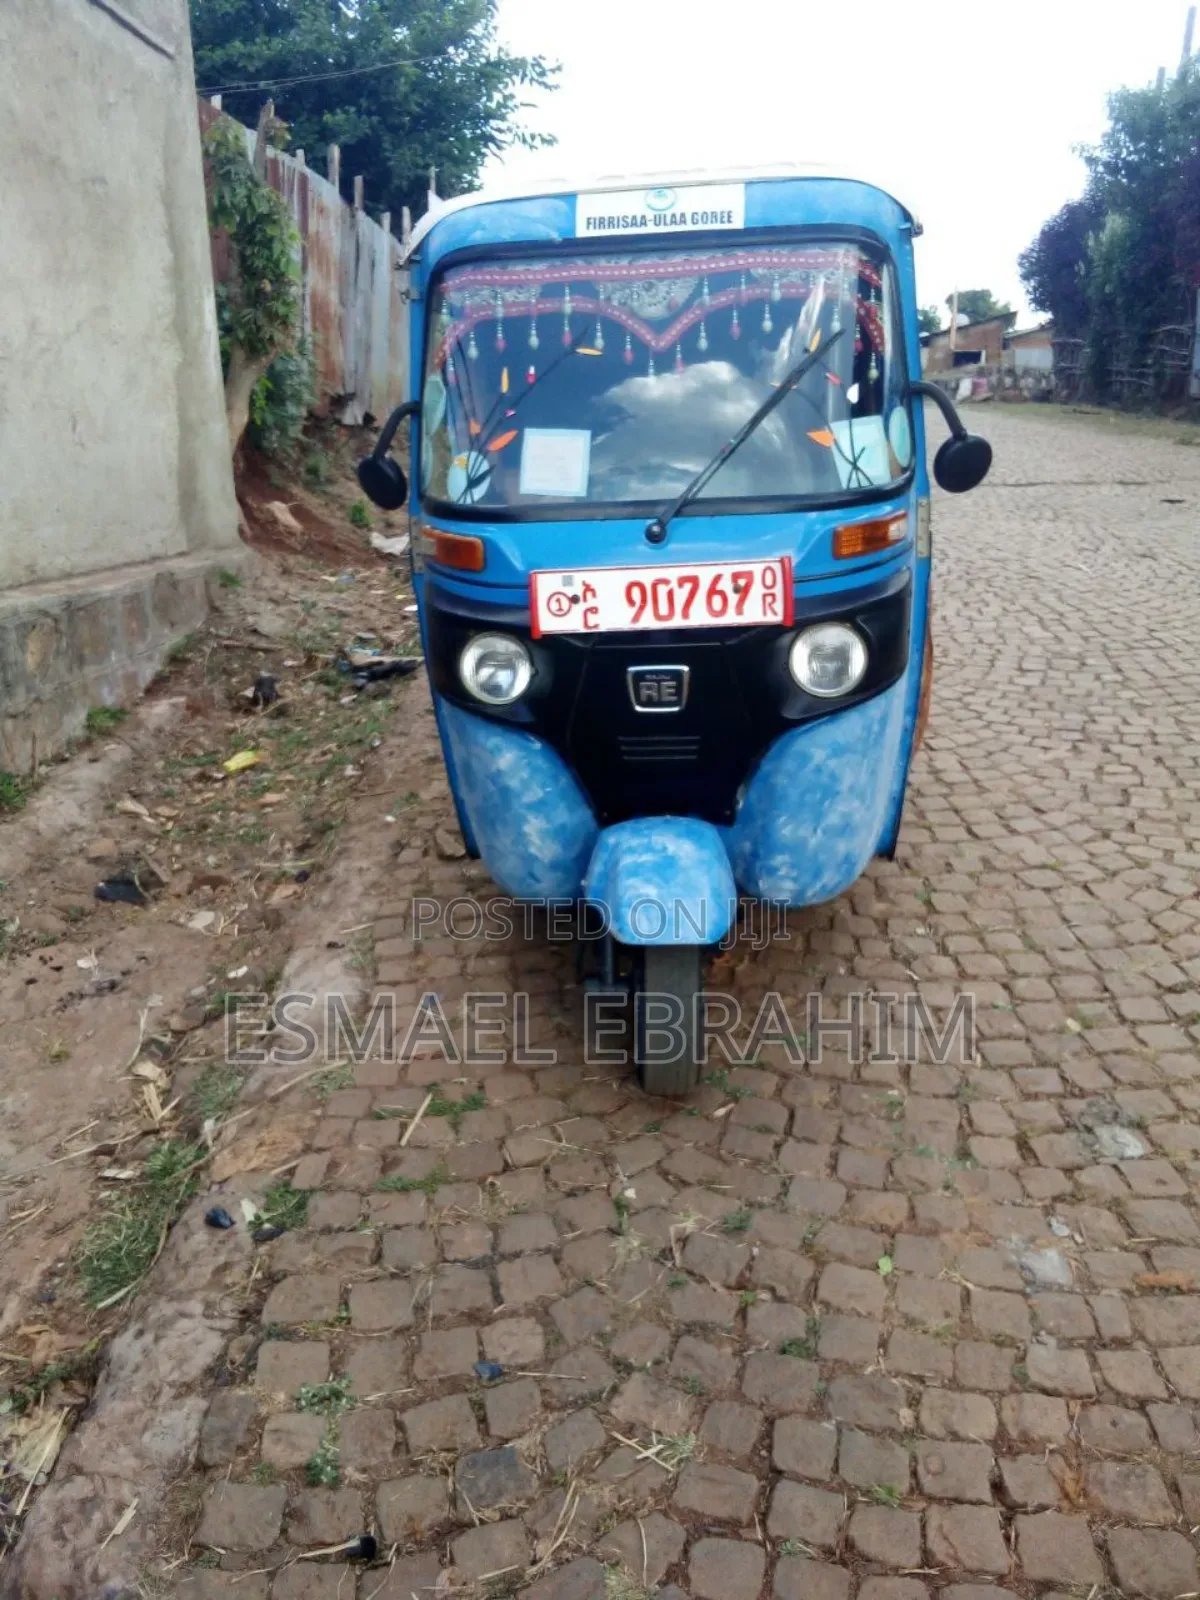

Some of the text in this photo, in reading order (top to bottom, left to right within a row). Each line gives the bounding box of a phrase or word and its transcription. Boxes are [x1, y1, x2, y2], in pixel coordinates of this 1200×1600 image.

[586, 210, 734, 231] FIRRISAA-ULAA GOREE
[625, 570, 755, 624] 90767
[639, 681, 679, 702] RE
